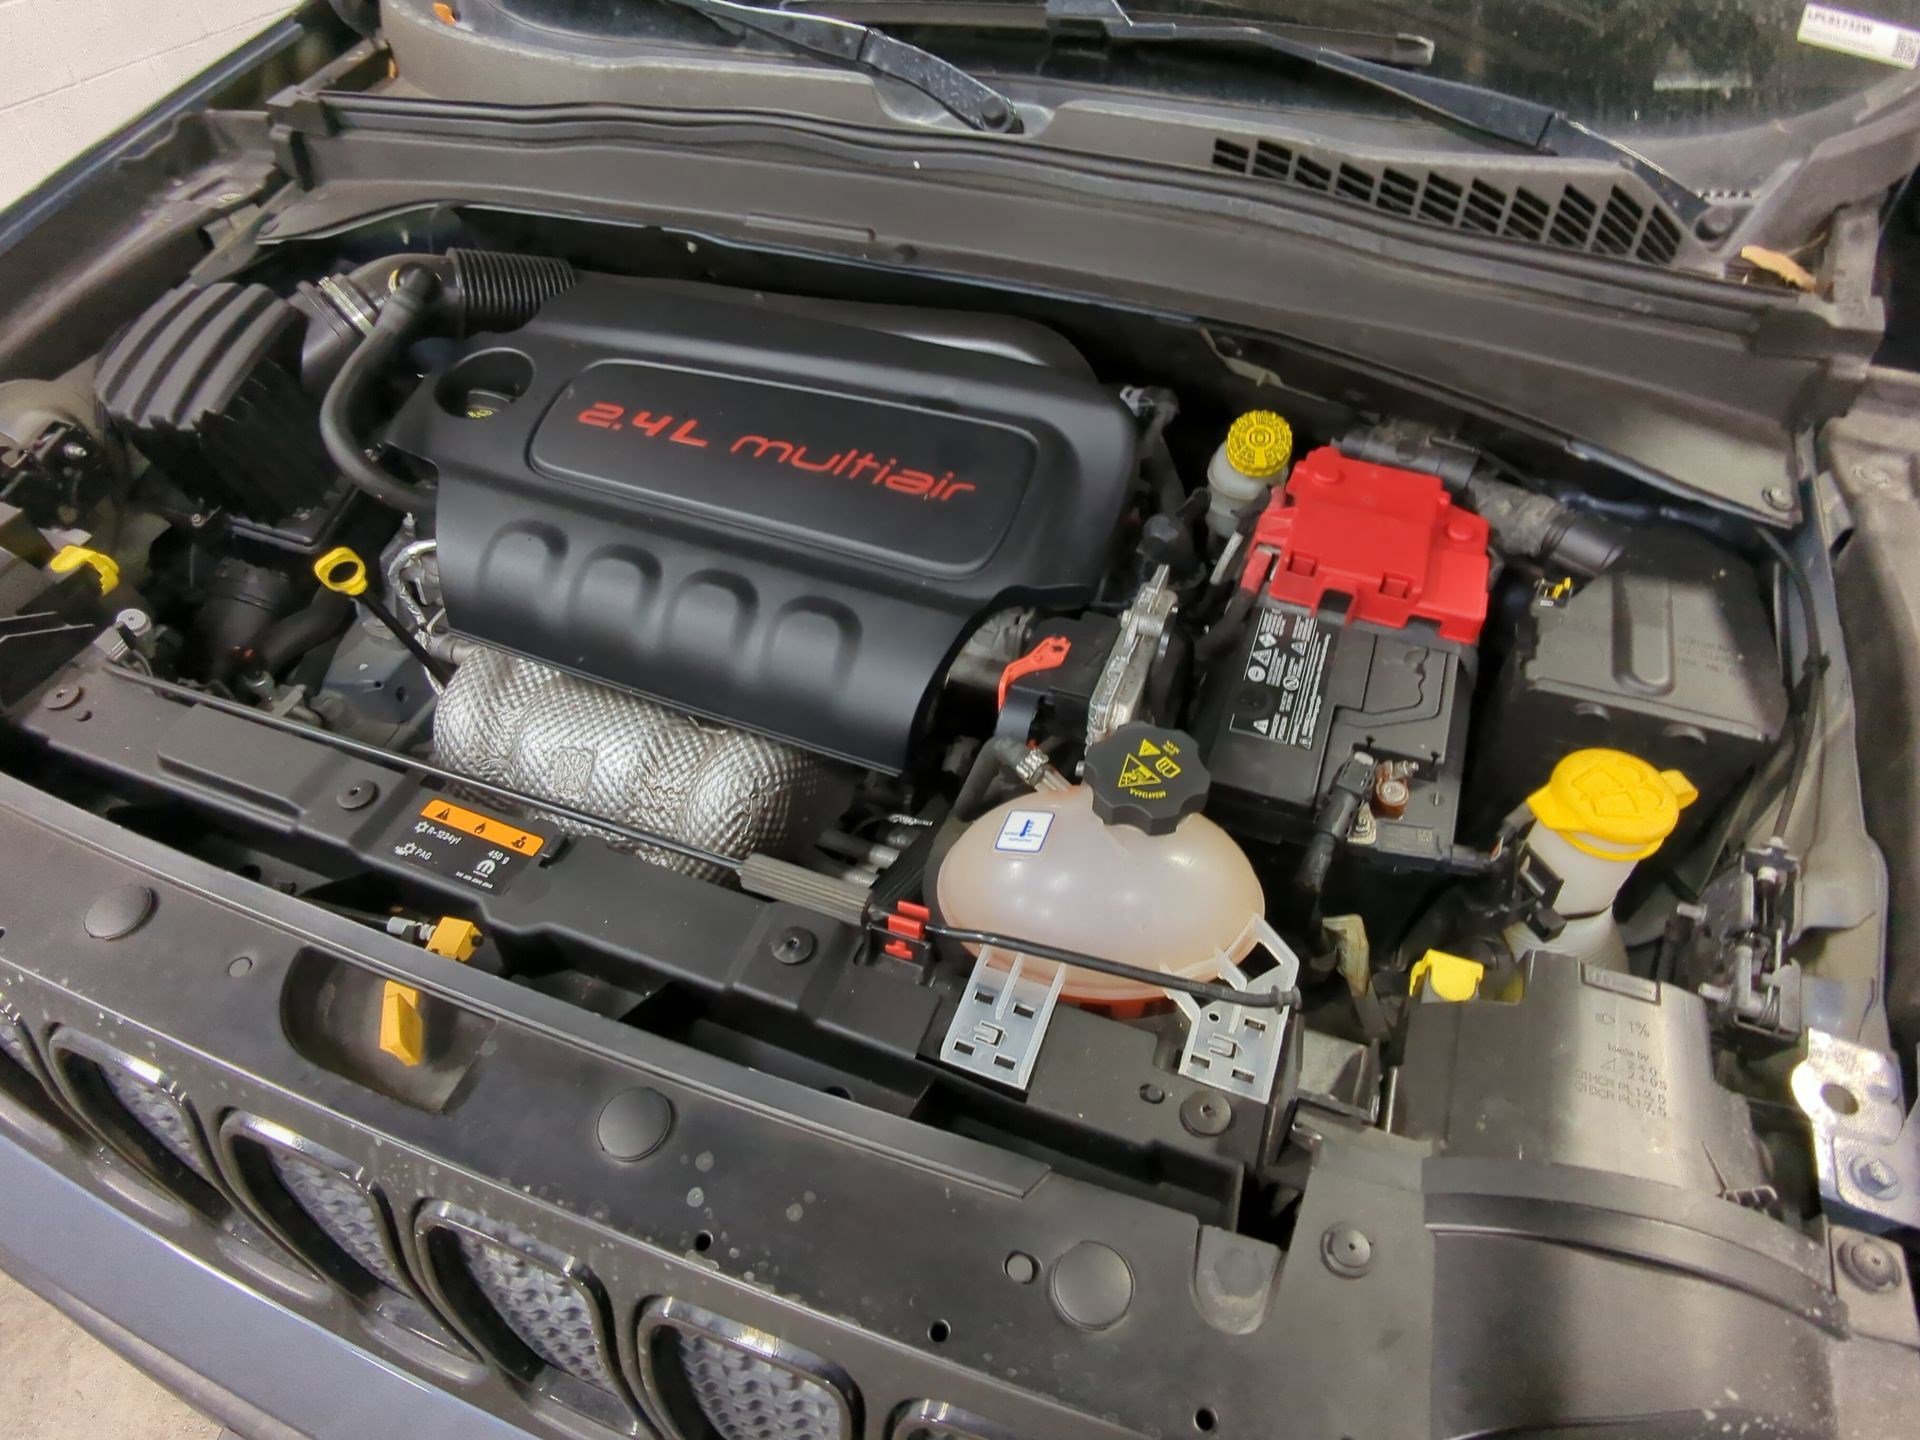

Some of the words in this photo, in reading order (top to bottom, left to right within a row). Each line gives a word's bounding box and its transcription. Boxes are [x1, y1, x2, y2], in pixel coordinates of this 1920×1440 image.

[577, 401, 709, 448] 2.4L
[730, 434, 977, 501] multiair
[414, 848, 433, 861] PAG
[487, 849, 502, 861] 450
